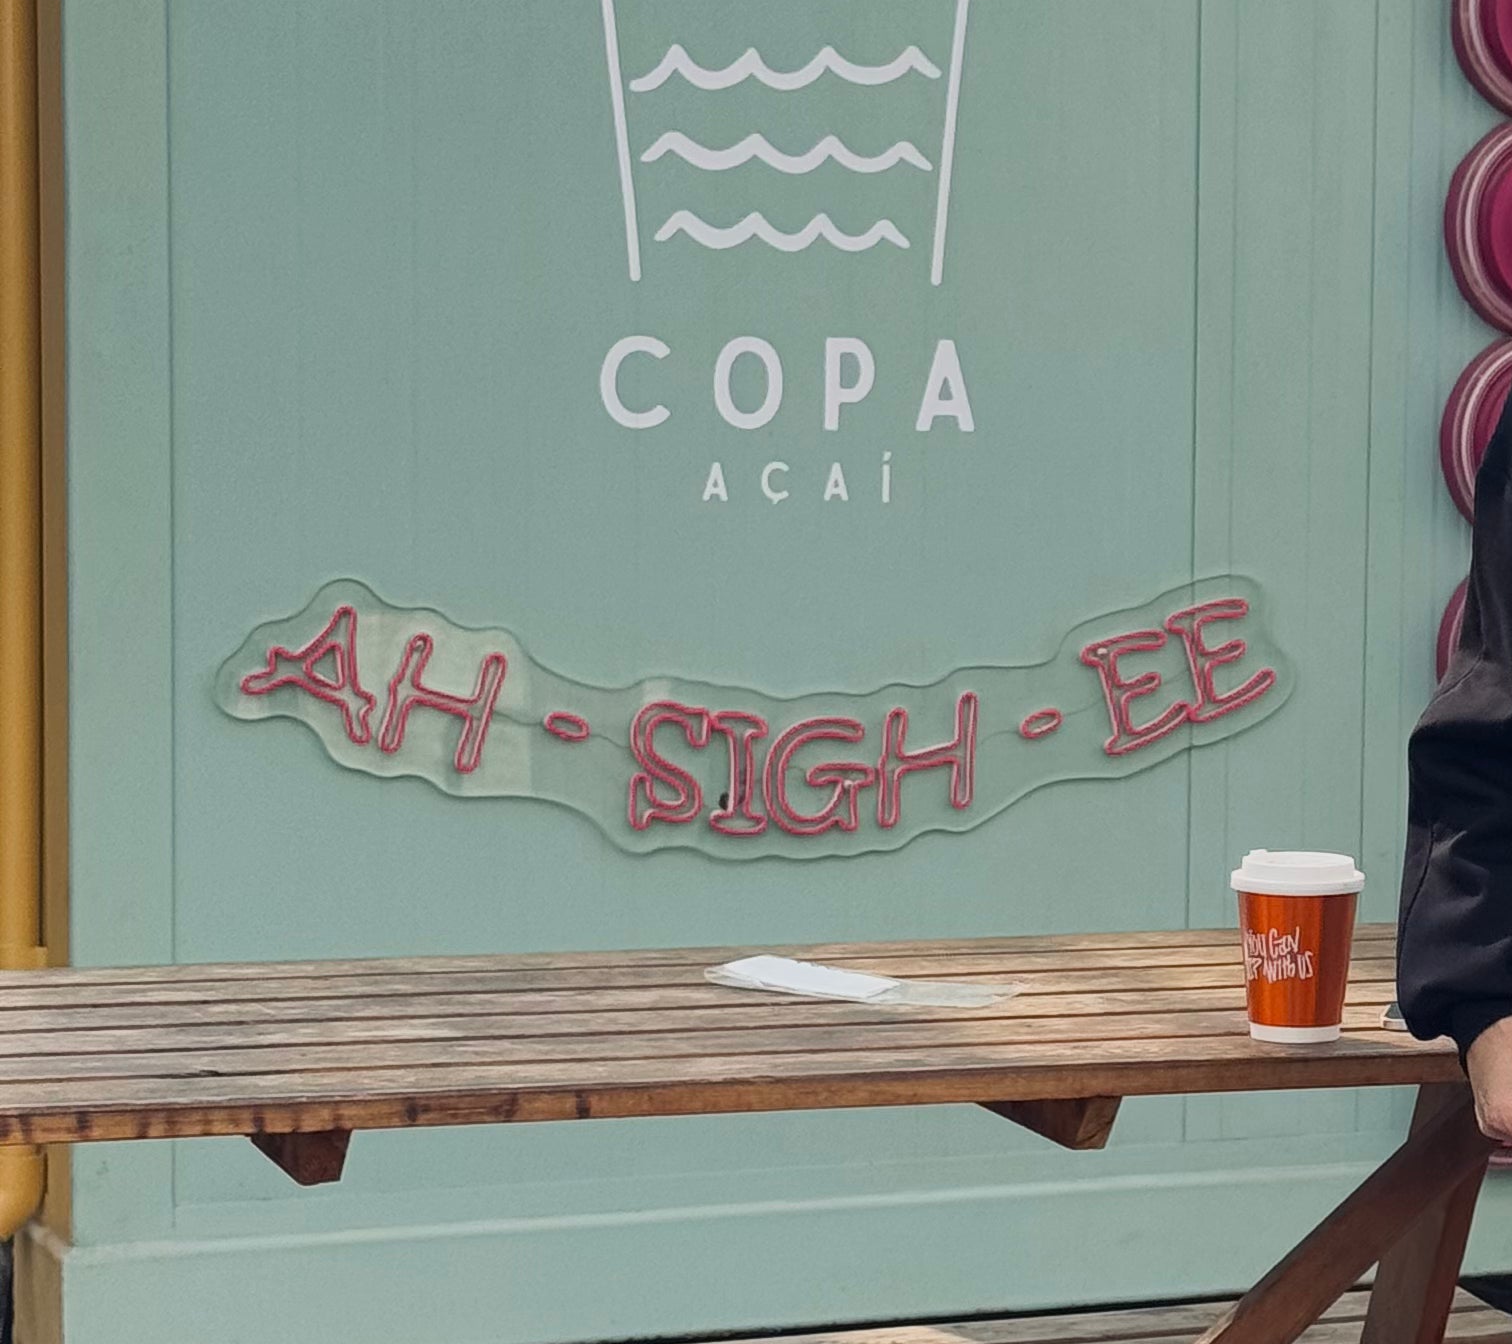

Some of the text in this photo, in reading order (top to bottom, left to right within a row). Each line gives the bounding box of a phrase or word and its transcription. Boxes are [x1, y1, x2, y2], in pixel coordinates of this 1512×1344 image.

[600, 335, 975, 432] COPA
[702, 450, 892, 505] AÇAÍ
[241, 606, 508, 774] AH
[628, 692, 979, 838] SIGH
[1080, 598, 1275, 755] EE
